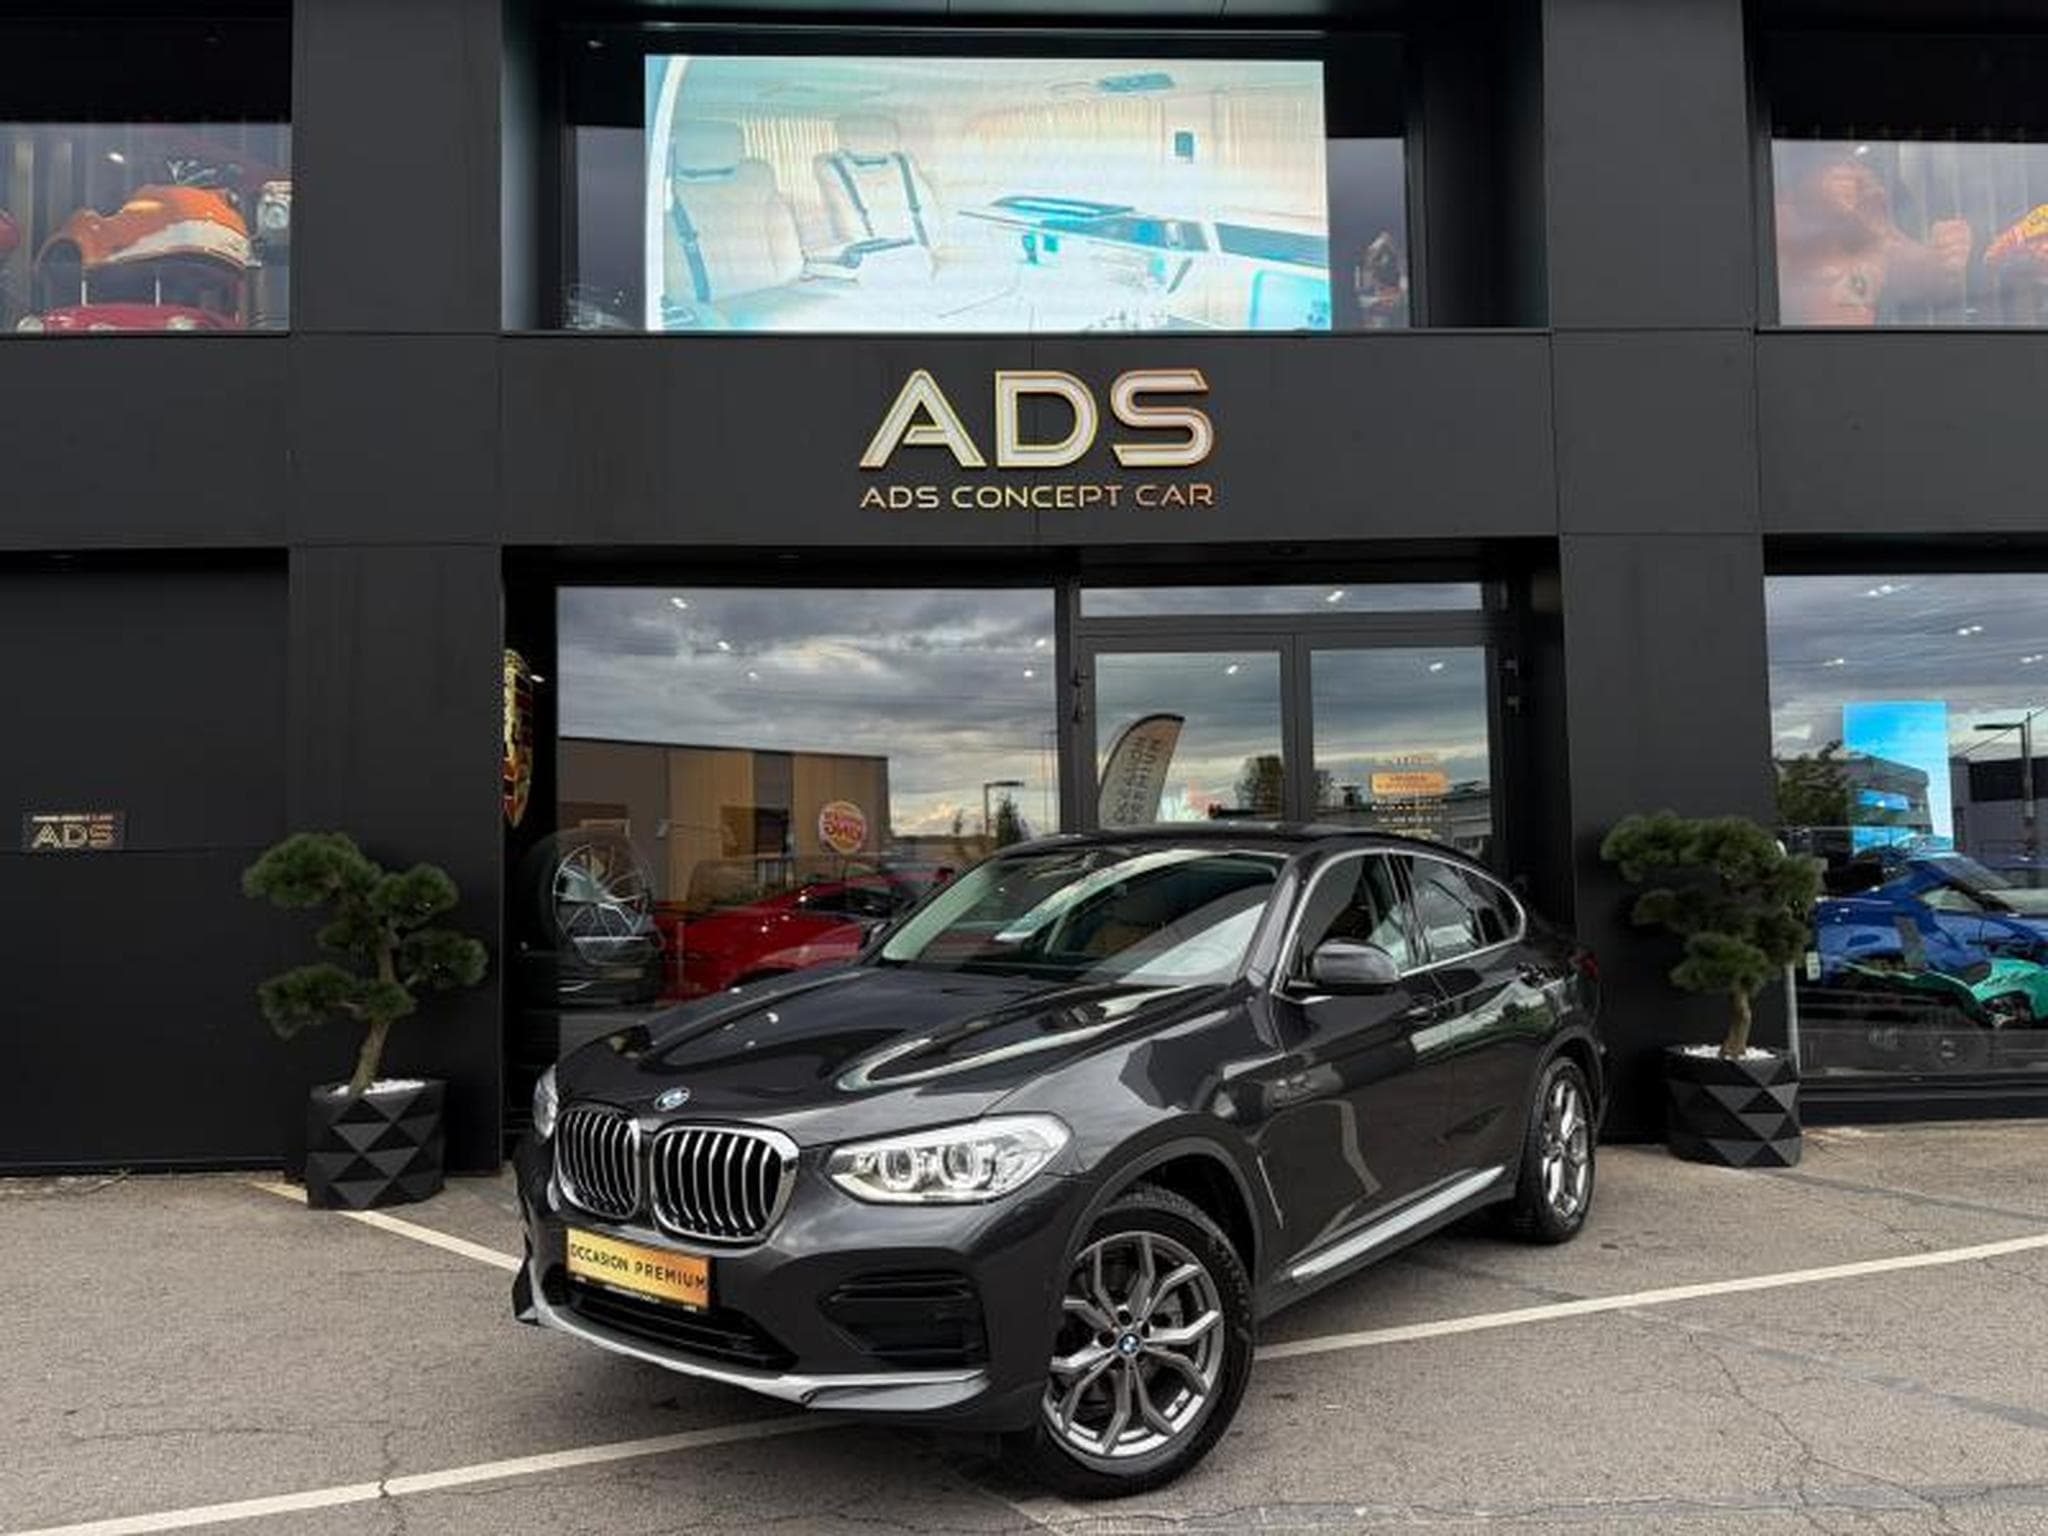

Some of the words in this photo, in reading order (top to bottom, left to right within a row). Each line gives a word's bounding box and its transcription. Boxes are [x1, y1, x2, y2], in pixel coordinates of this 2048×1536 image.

[859, 368, 1214, 468] ADS
[860, 486, 940, 509] ADS
[951, 485, 1123, 509] CONCEPT
[1135, 483, 1215, 508] CAR
[31, 823, 114, 849] ADS
[570, 1243, 629, 1272] OCCASION
[634, 1260, 706, 1289] PREMIUM
